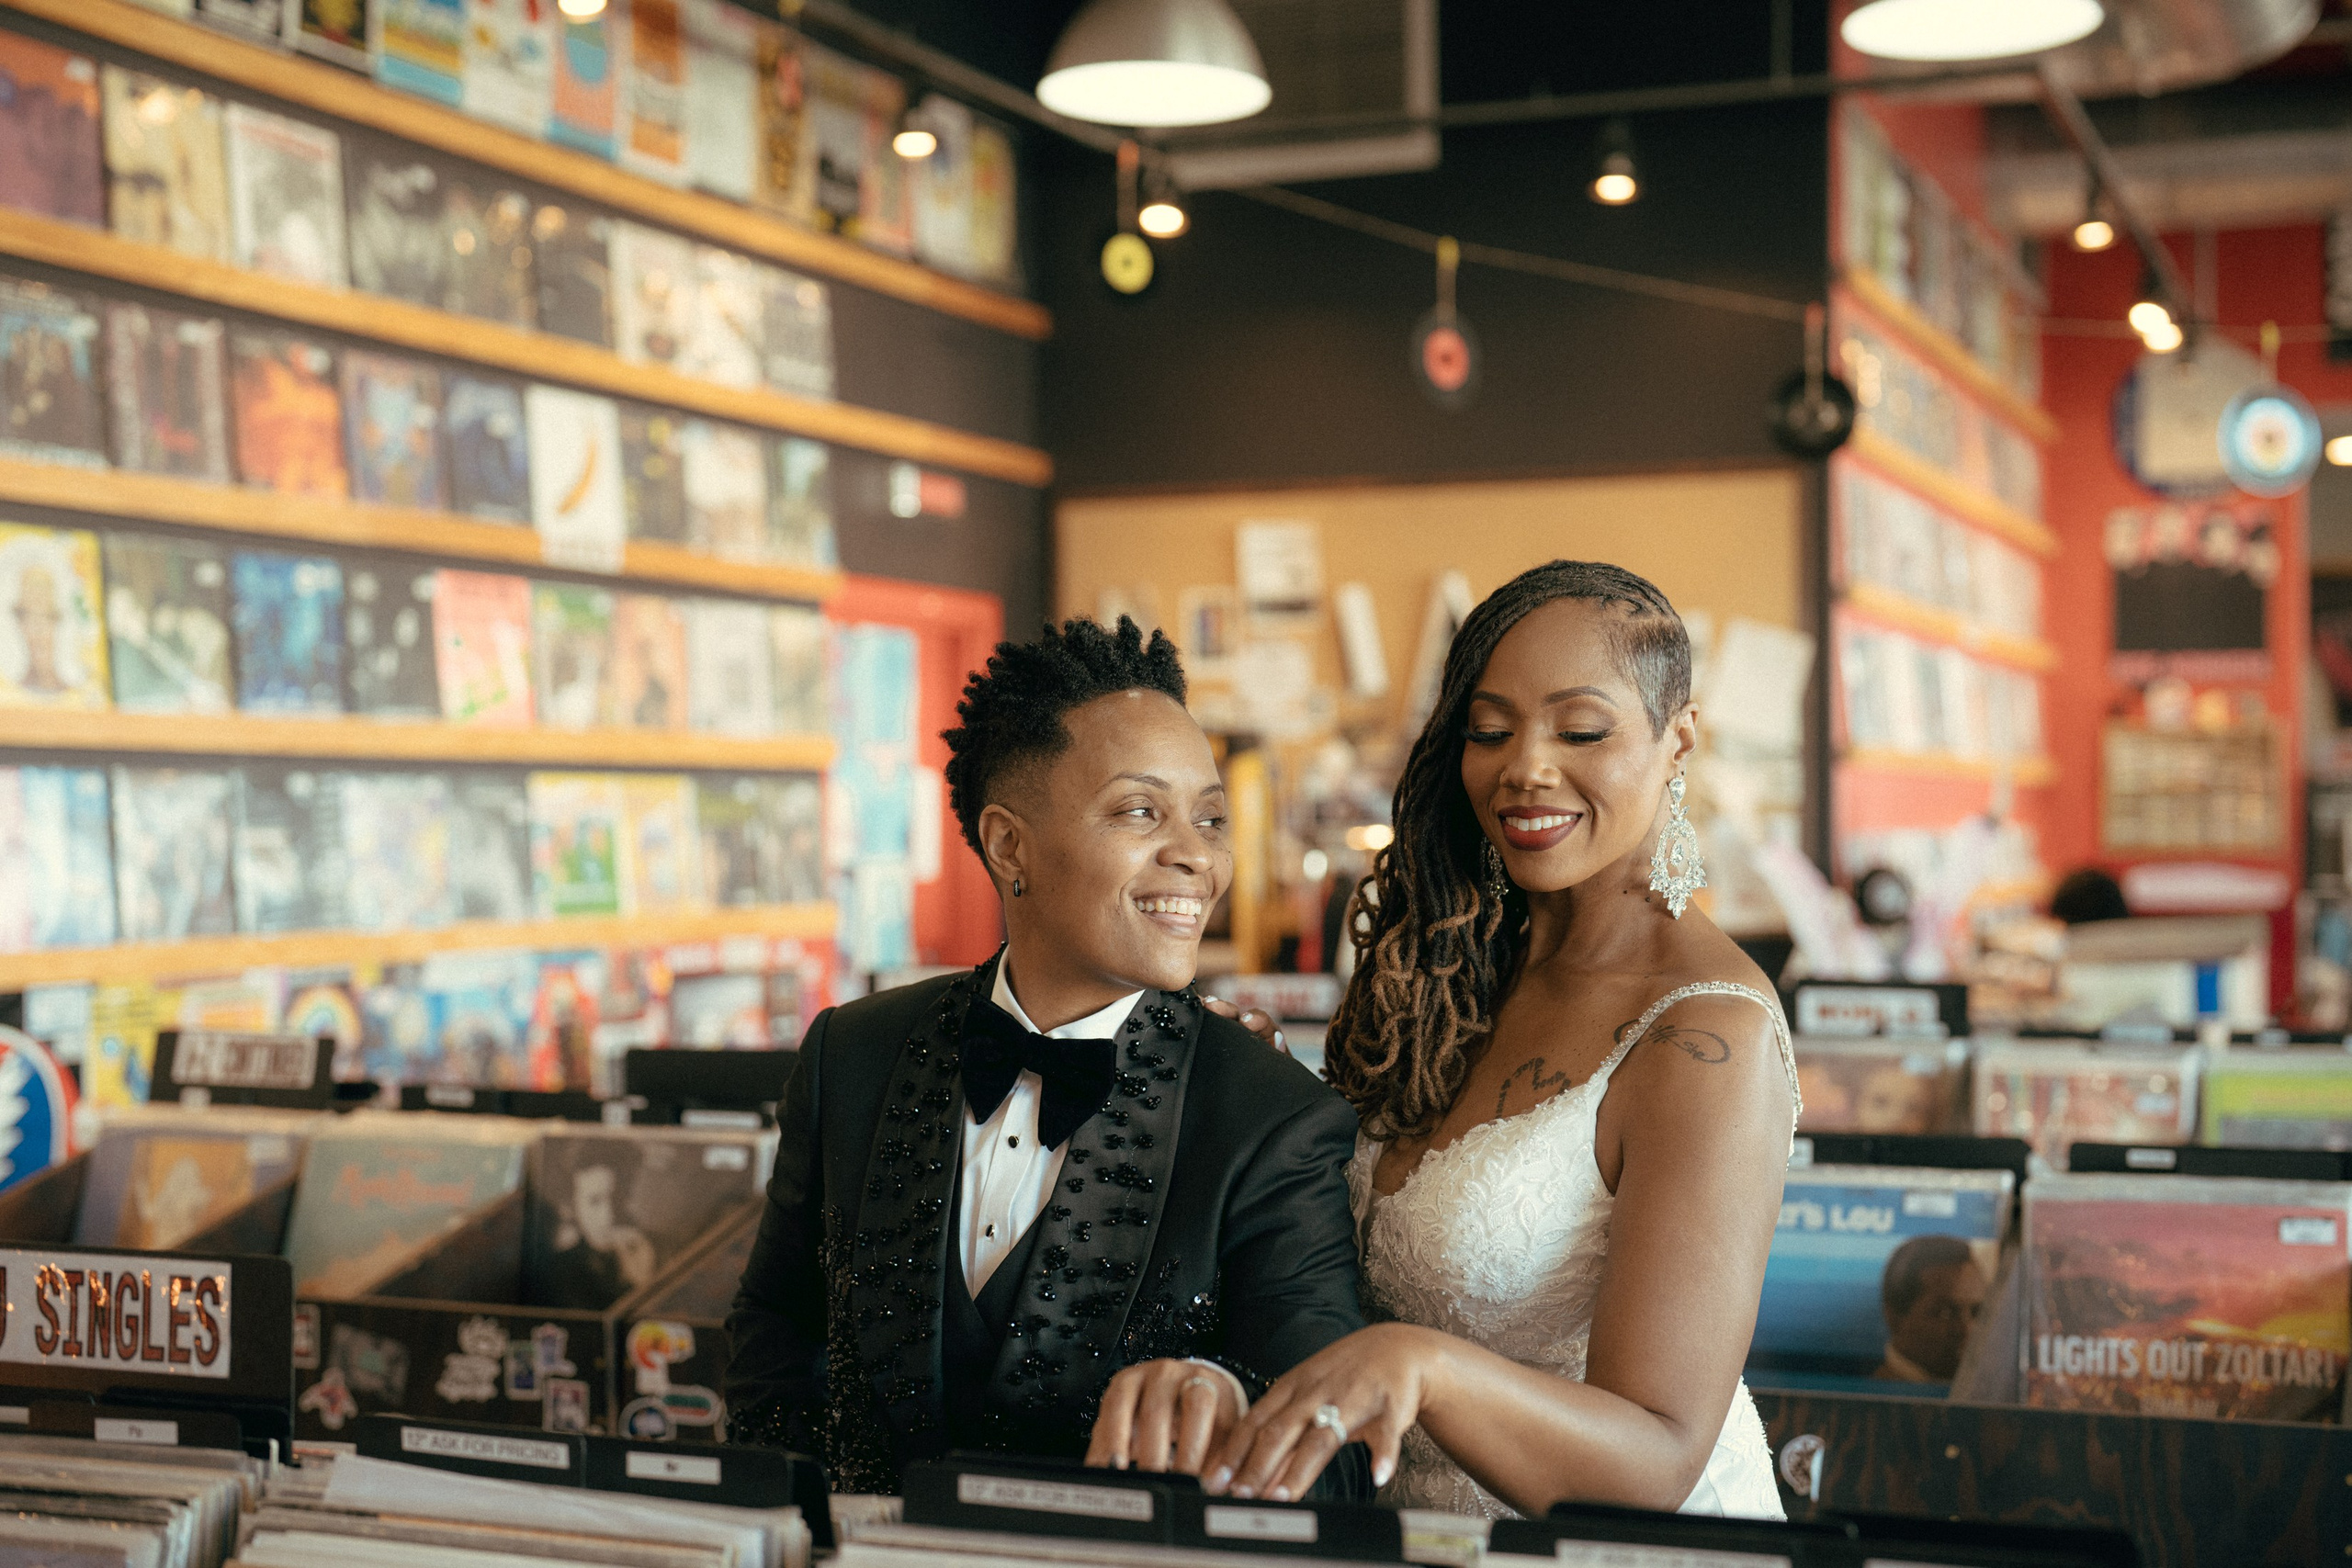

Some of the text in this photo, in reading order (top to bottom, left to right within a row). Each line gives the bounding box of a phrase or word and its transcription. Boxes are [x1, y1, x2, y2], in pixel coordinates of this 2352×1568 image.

[35, 1264, 221, 1367] SINGLES
[2038, 1335, 2336, 1390] LIGHTS OUT ZOLTAR!
[430, 1434, 459, 1450] ASK
[461, 1438, 495, 1454] FOR
[498, 1441, 560, 1462] PRICING
